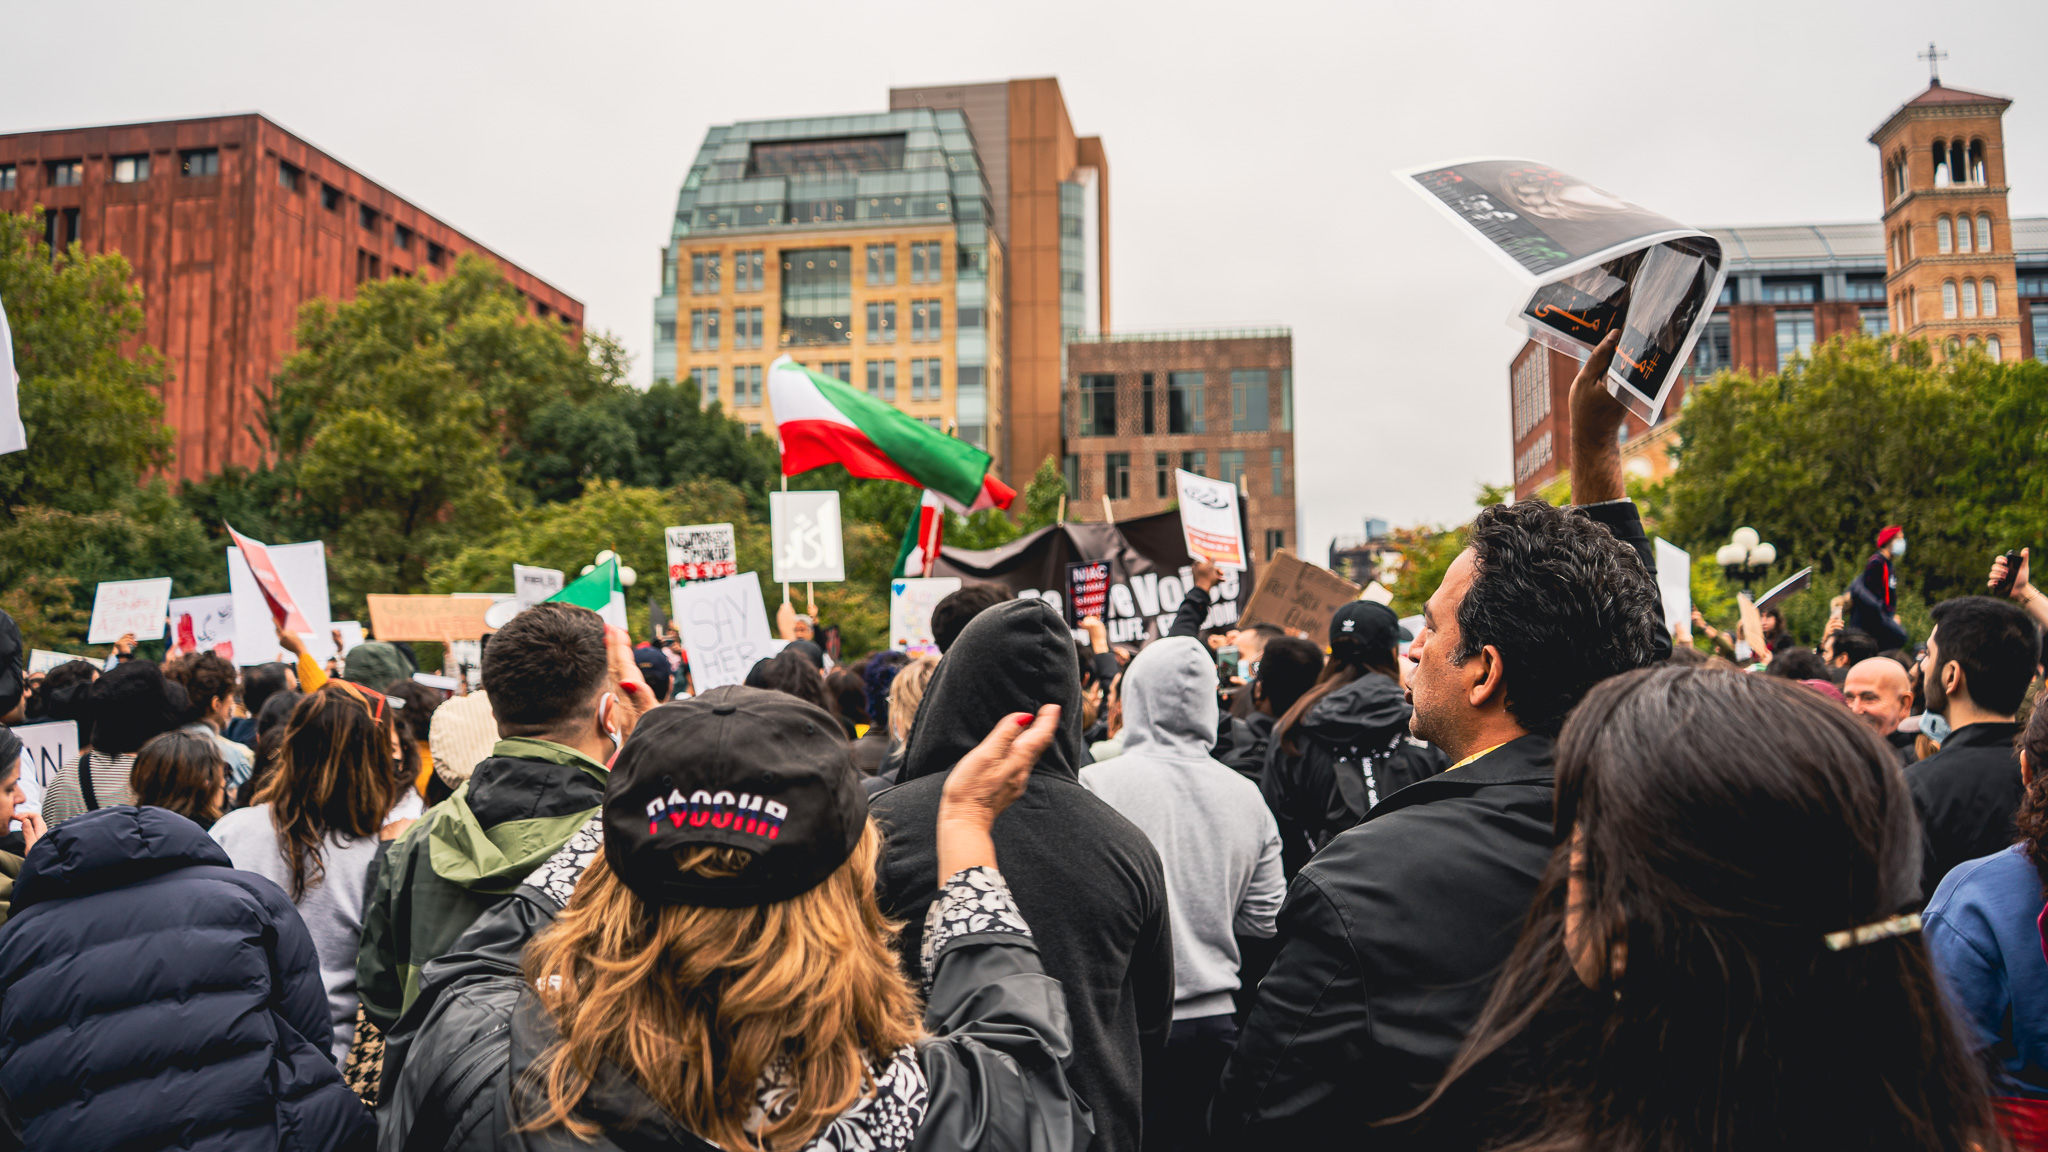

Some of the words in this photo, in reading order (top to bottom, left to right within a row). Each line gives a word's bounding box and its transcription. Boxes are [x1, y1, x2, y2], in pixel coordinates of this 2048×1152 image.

[1072, 564, 1108, 583] NIAC
[1074, 580, 1107, 595] SHAME
[1075, 592, 1107, 606] SHAME
[688, 589, 748, 652] SAY
[1108, 616, 1150, 643] LIFE.
[1156, 600, 1240, 637] FRDOM.
[698, 641, 758, 680] HER
[646, 788, 788, 840] РОССИЯ
